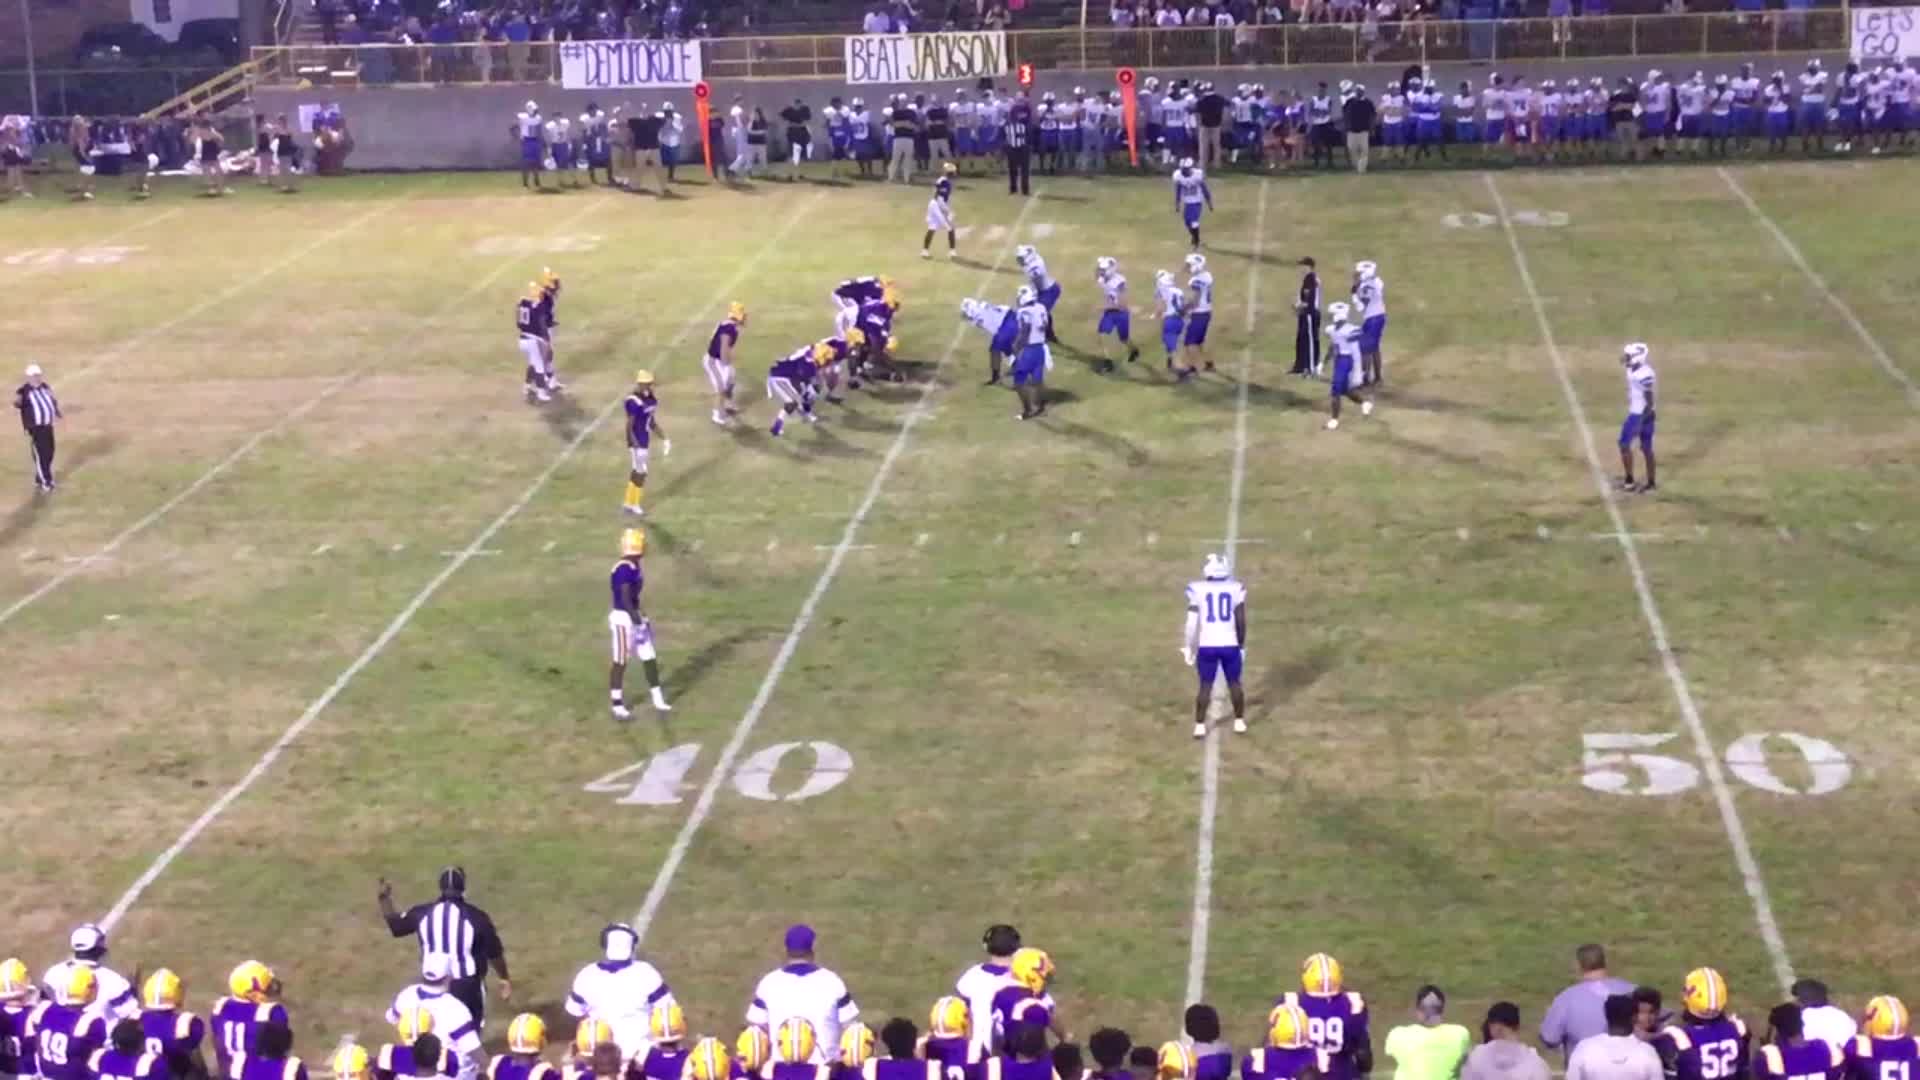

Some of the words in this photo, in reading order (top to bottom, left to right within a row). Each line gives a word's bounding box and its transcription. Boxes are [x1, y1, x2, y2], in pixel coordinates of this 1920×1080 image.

[851, 38, 904, 81] BEAT
[907, 35, 1001, 80] JACKSON
[1862, 32, 1899, 56] GO
[1205, 592, 1232, 623] 10
[583, 741, 854, 804] 40
[1581, 732, 1851, 795] 50
[41, 1029, 68, 1065] 19
[224, 1021, 246, 1055] 11
[1308, 1016, 1344, 1054] 99
[1700, 1039, 1738, 1079] 52
